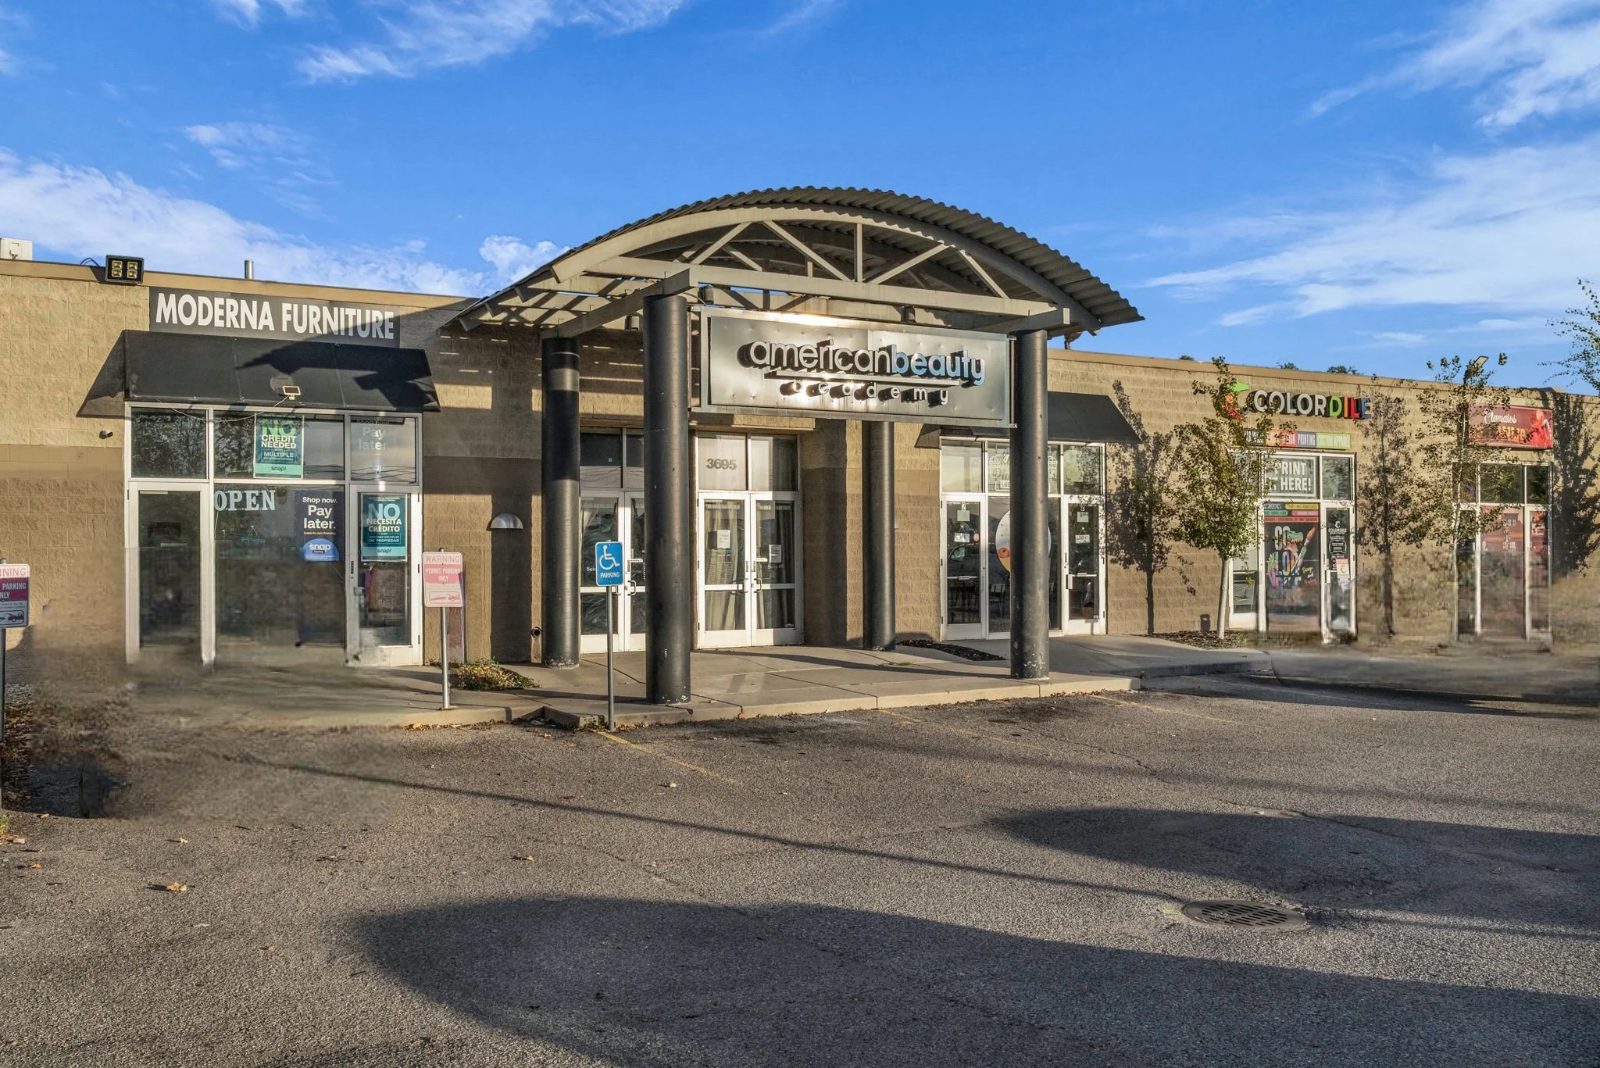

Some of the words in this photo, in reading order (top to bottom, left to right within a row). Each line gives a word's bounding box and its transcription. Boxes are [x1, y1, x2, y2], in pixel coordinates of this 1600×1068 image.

[156, 292, 275, 331] MODERNA
[281, 302, 394, 340] FURNITURE
[1253, 389, 1373, 419] COLORDILE
[262, 421, 297, 436] NO
[261, 434, 297, 443] CREDIT
[261, 441, 297, 449] NEEDED
[706, 458, 737, 470] 3695
[1274, 461, 1306, 476] PRINT
[1280, 477, 1311, 491] HERE!
[214, 490, 276, 511] OPEN
[302, 496, 321, 504] Shop
[308, 505, 333, 518] Pay
[368, 503, 400, 519] NO
[303, 518, 336, 529] later.
[2, 582, 27, 590] PARKING
